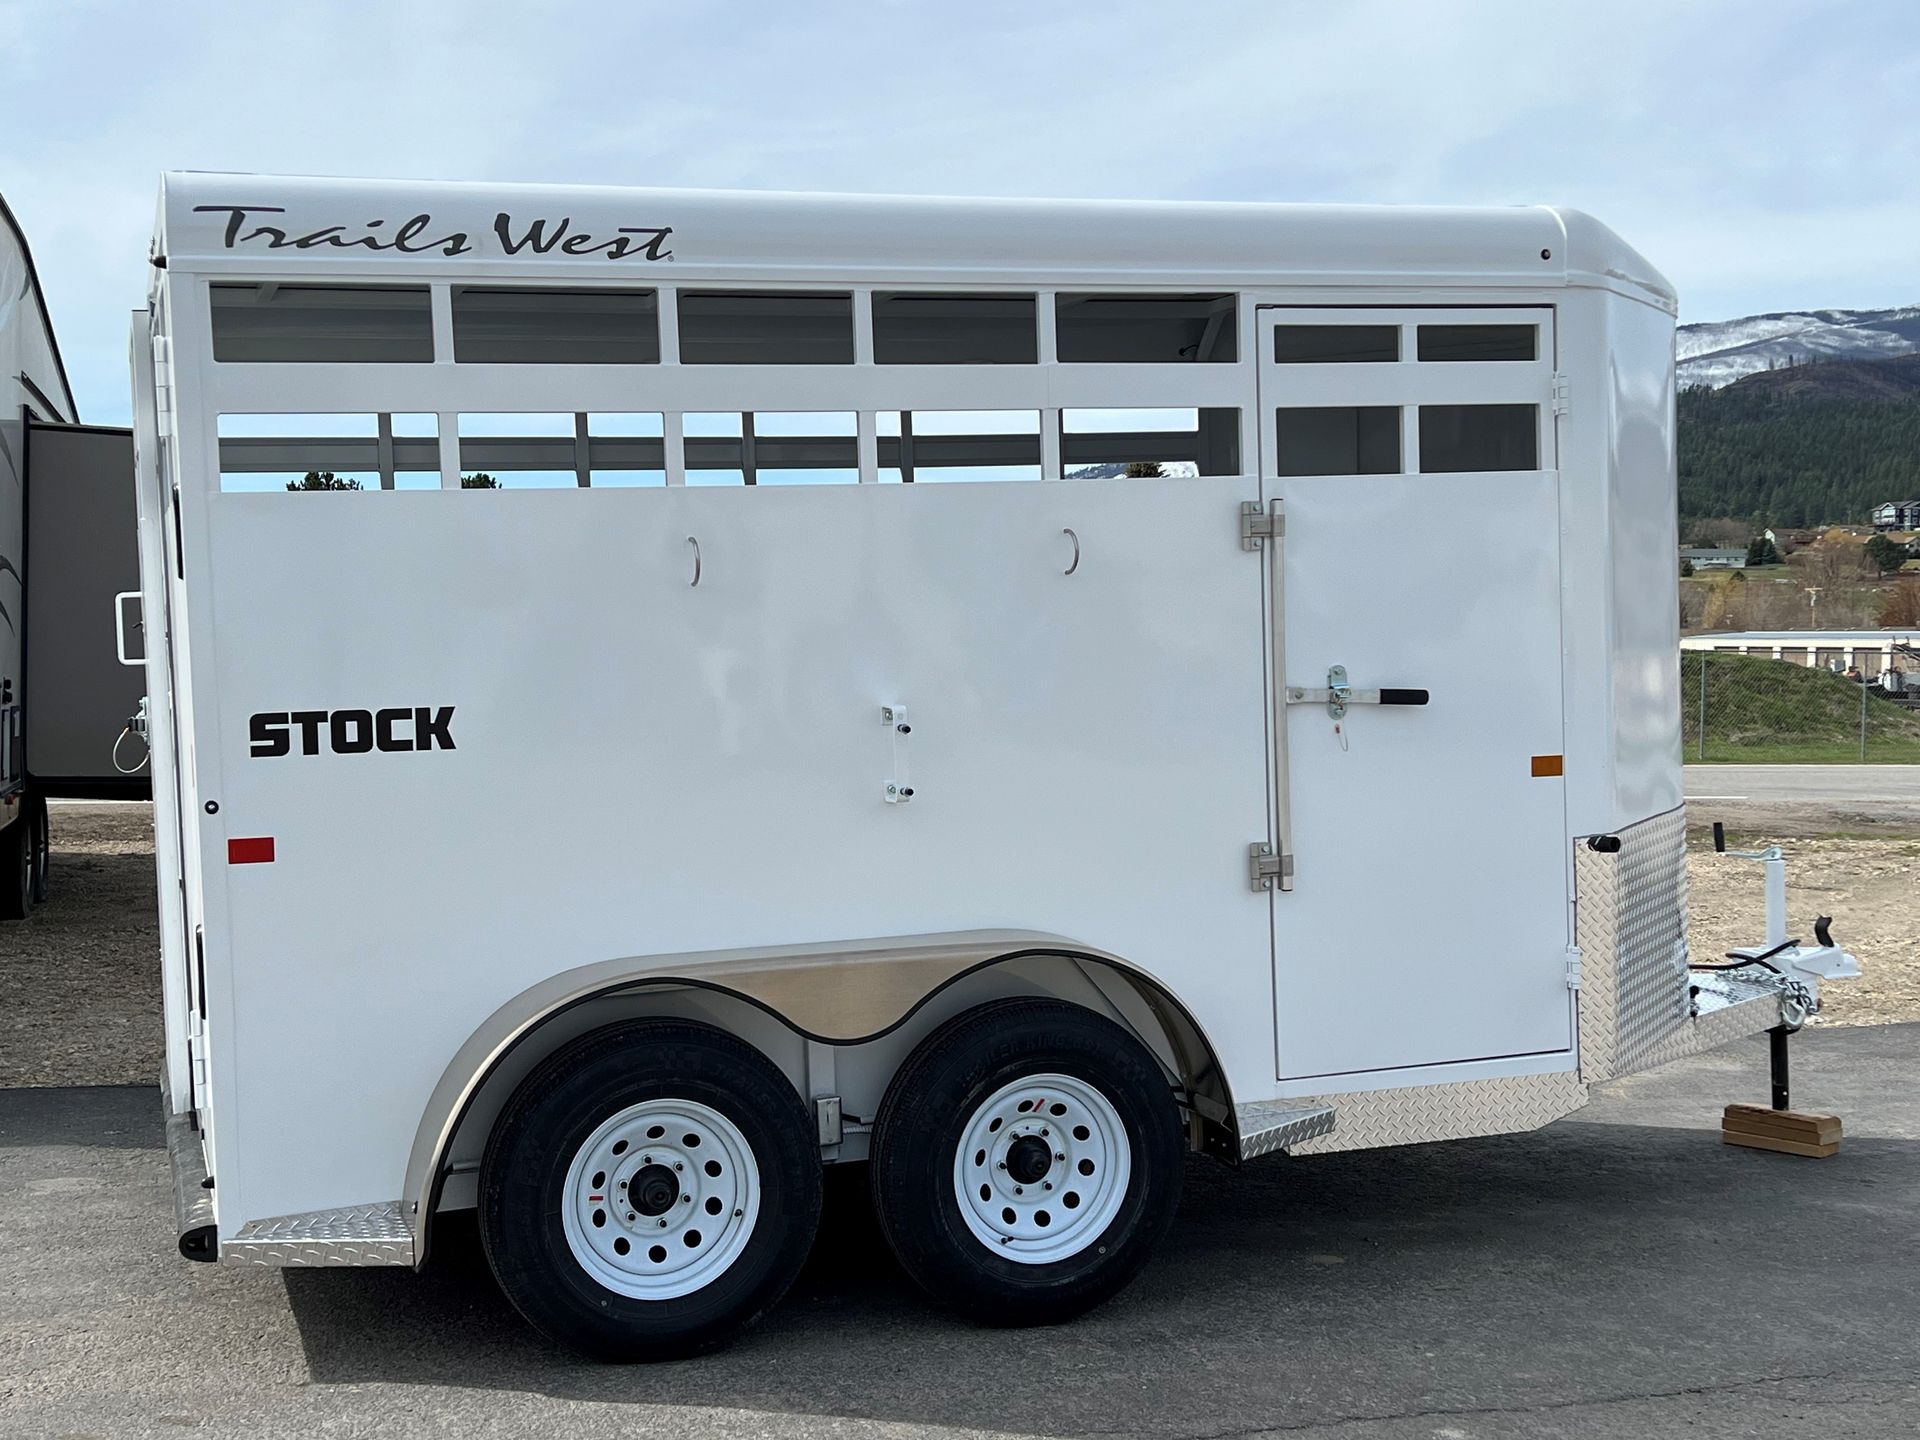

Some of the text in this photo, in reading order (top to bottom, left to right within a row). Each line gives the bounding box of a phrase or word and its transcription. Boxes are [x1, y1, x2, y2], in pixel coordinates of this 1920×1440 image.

[193, 206, 673, 261] Trails West
[249, 706, 457, 757] STOCK
